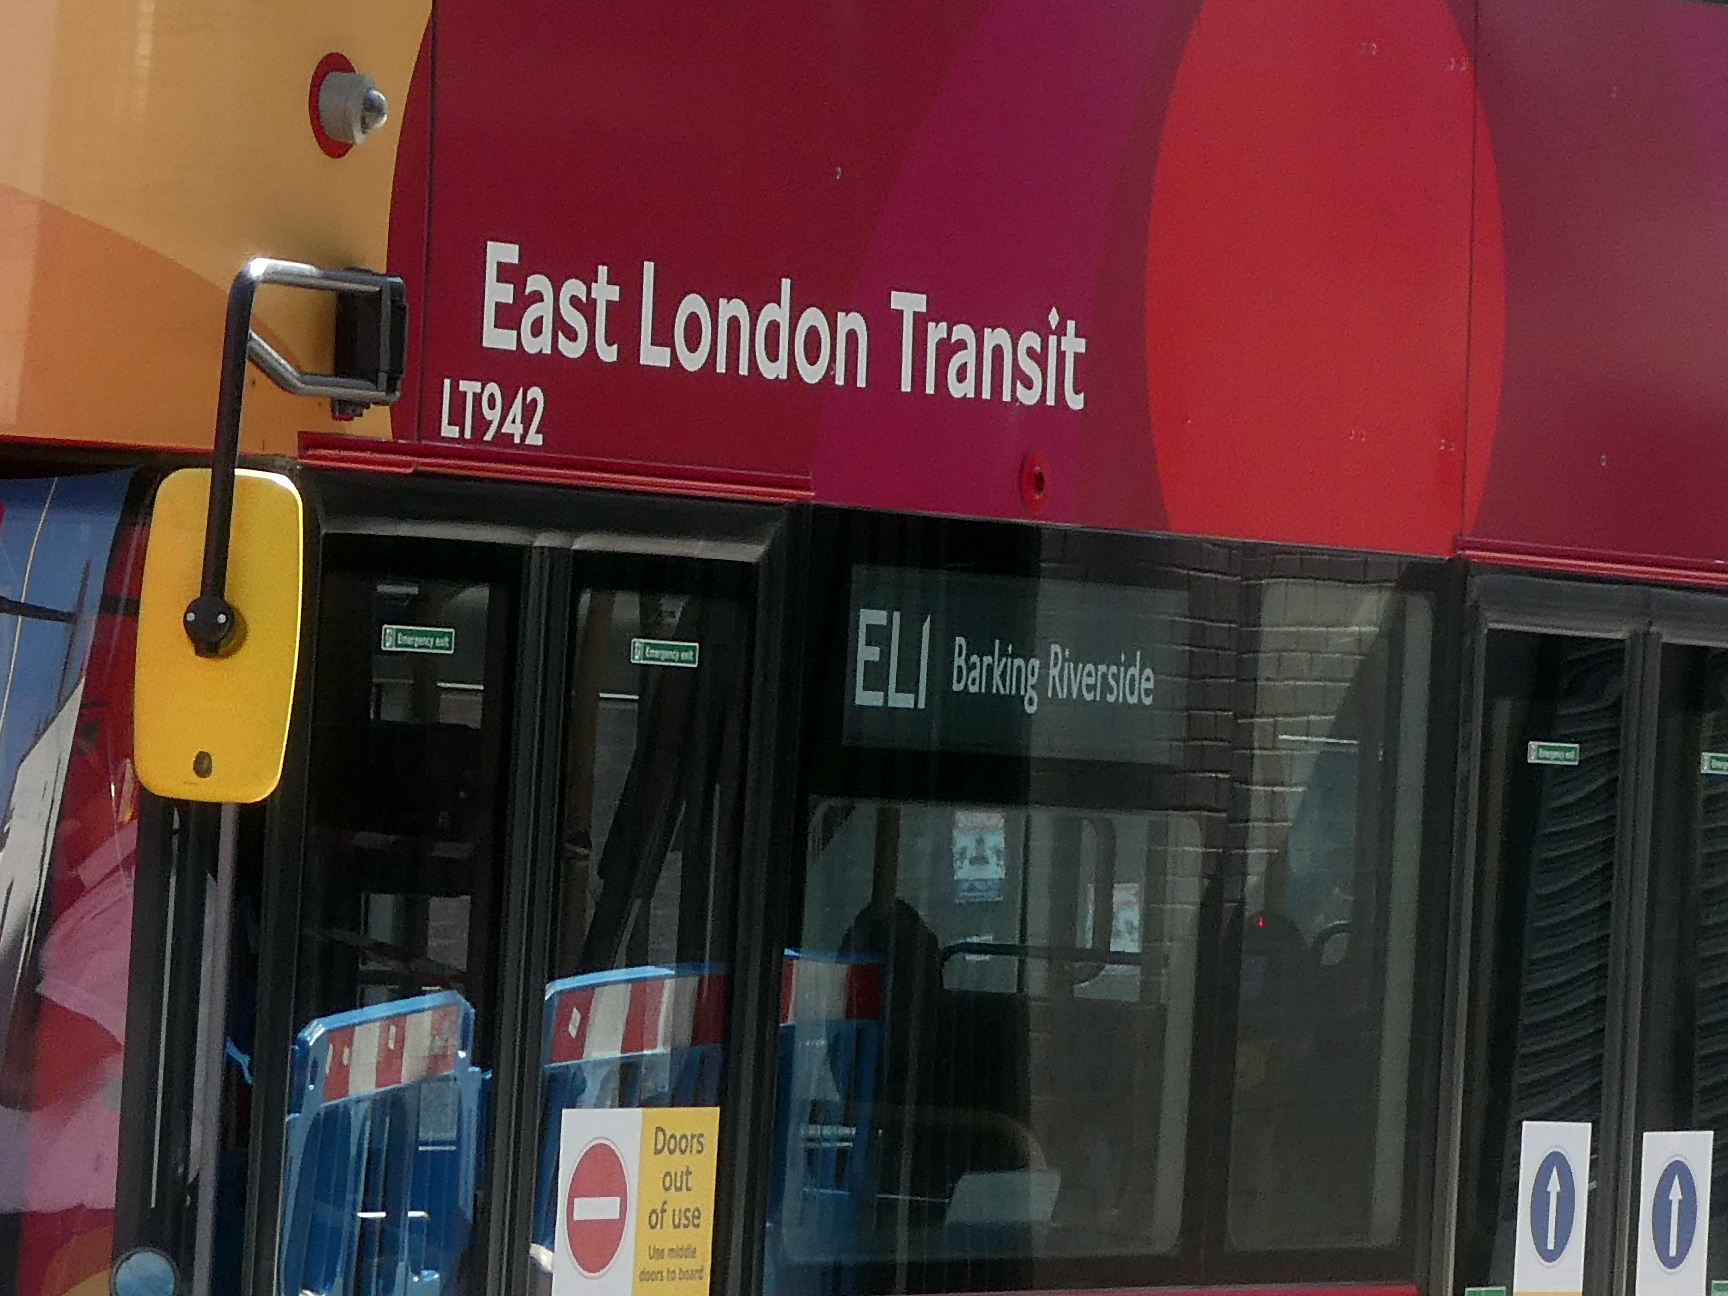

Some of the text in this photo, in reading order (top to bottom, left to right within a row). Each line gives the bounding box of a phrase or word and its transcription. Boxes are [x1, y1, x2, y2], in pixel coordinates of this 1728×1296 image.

[482, 241, 1086, 410] East London Transit
[440, 378, 545, 445] LT942
[854, 609, 1155, 714] EL1 Barking Riverside
[654, 1126, 705, 1155] Doors
[662, 1166, 693, 1192] out
[648, 1201, 702, 1230] of use
[648, 1244, 697, 1260] Use middle
[639, 1267, 664, 1282] doors
[678, 1265, 704, 1281] board
